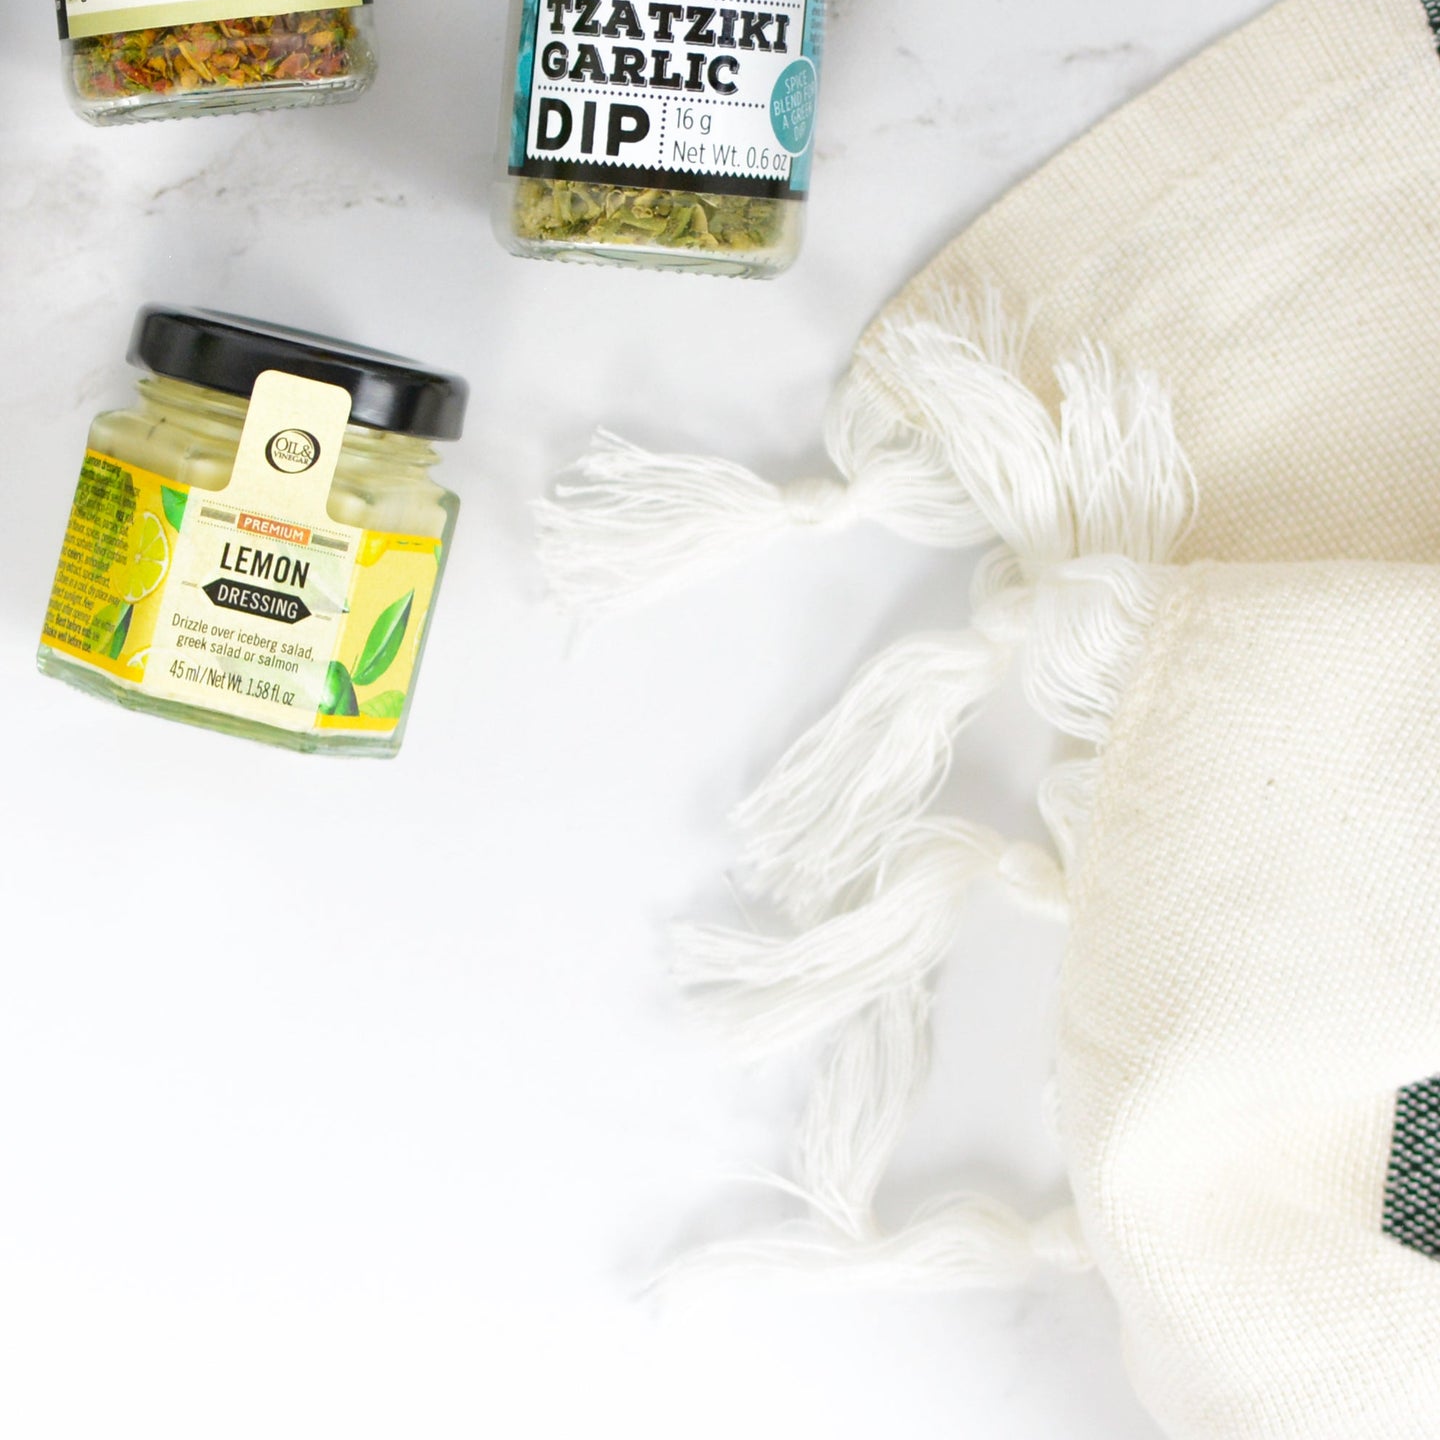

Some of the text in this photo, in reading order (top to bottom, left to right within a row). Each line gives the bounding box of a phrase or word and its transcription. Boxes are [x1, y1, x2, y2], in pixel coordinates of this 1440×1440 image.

[541, 40, 741, 96] GARLIC
[784, 70, 808, 95] SPICE
[773, 90, 803, 117] BLEND
[535, 96, 651, 157] DIP
[676, 107, 712, 134] 16 g
[782, 115, 789, 129] A
[672, 140, 789, 172] Net Wt. 0.6 oz
[273, 451, 310, 466] VINEGAR
[243, 517, 304, 541] PREMIUM
[220, 542, 310, 588] LEMON
[217, 584, 299, 619] DRESSING
[172, 613, 315, 661] Drizzle over iceberg salad,
[176, 634, 300, 673] greek salad or salmon
[169, 659, 186, 679] 45
[186, 665, 200, 682] ml
[206, 668, 226, 689] Net
[227, 673, 243, 694] Wt.
[246, 678, 270, 699] 1.58
[282, 691, 296, 706] oz
